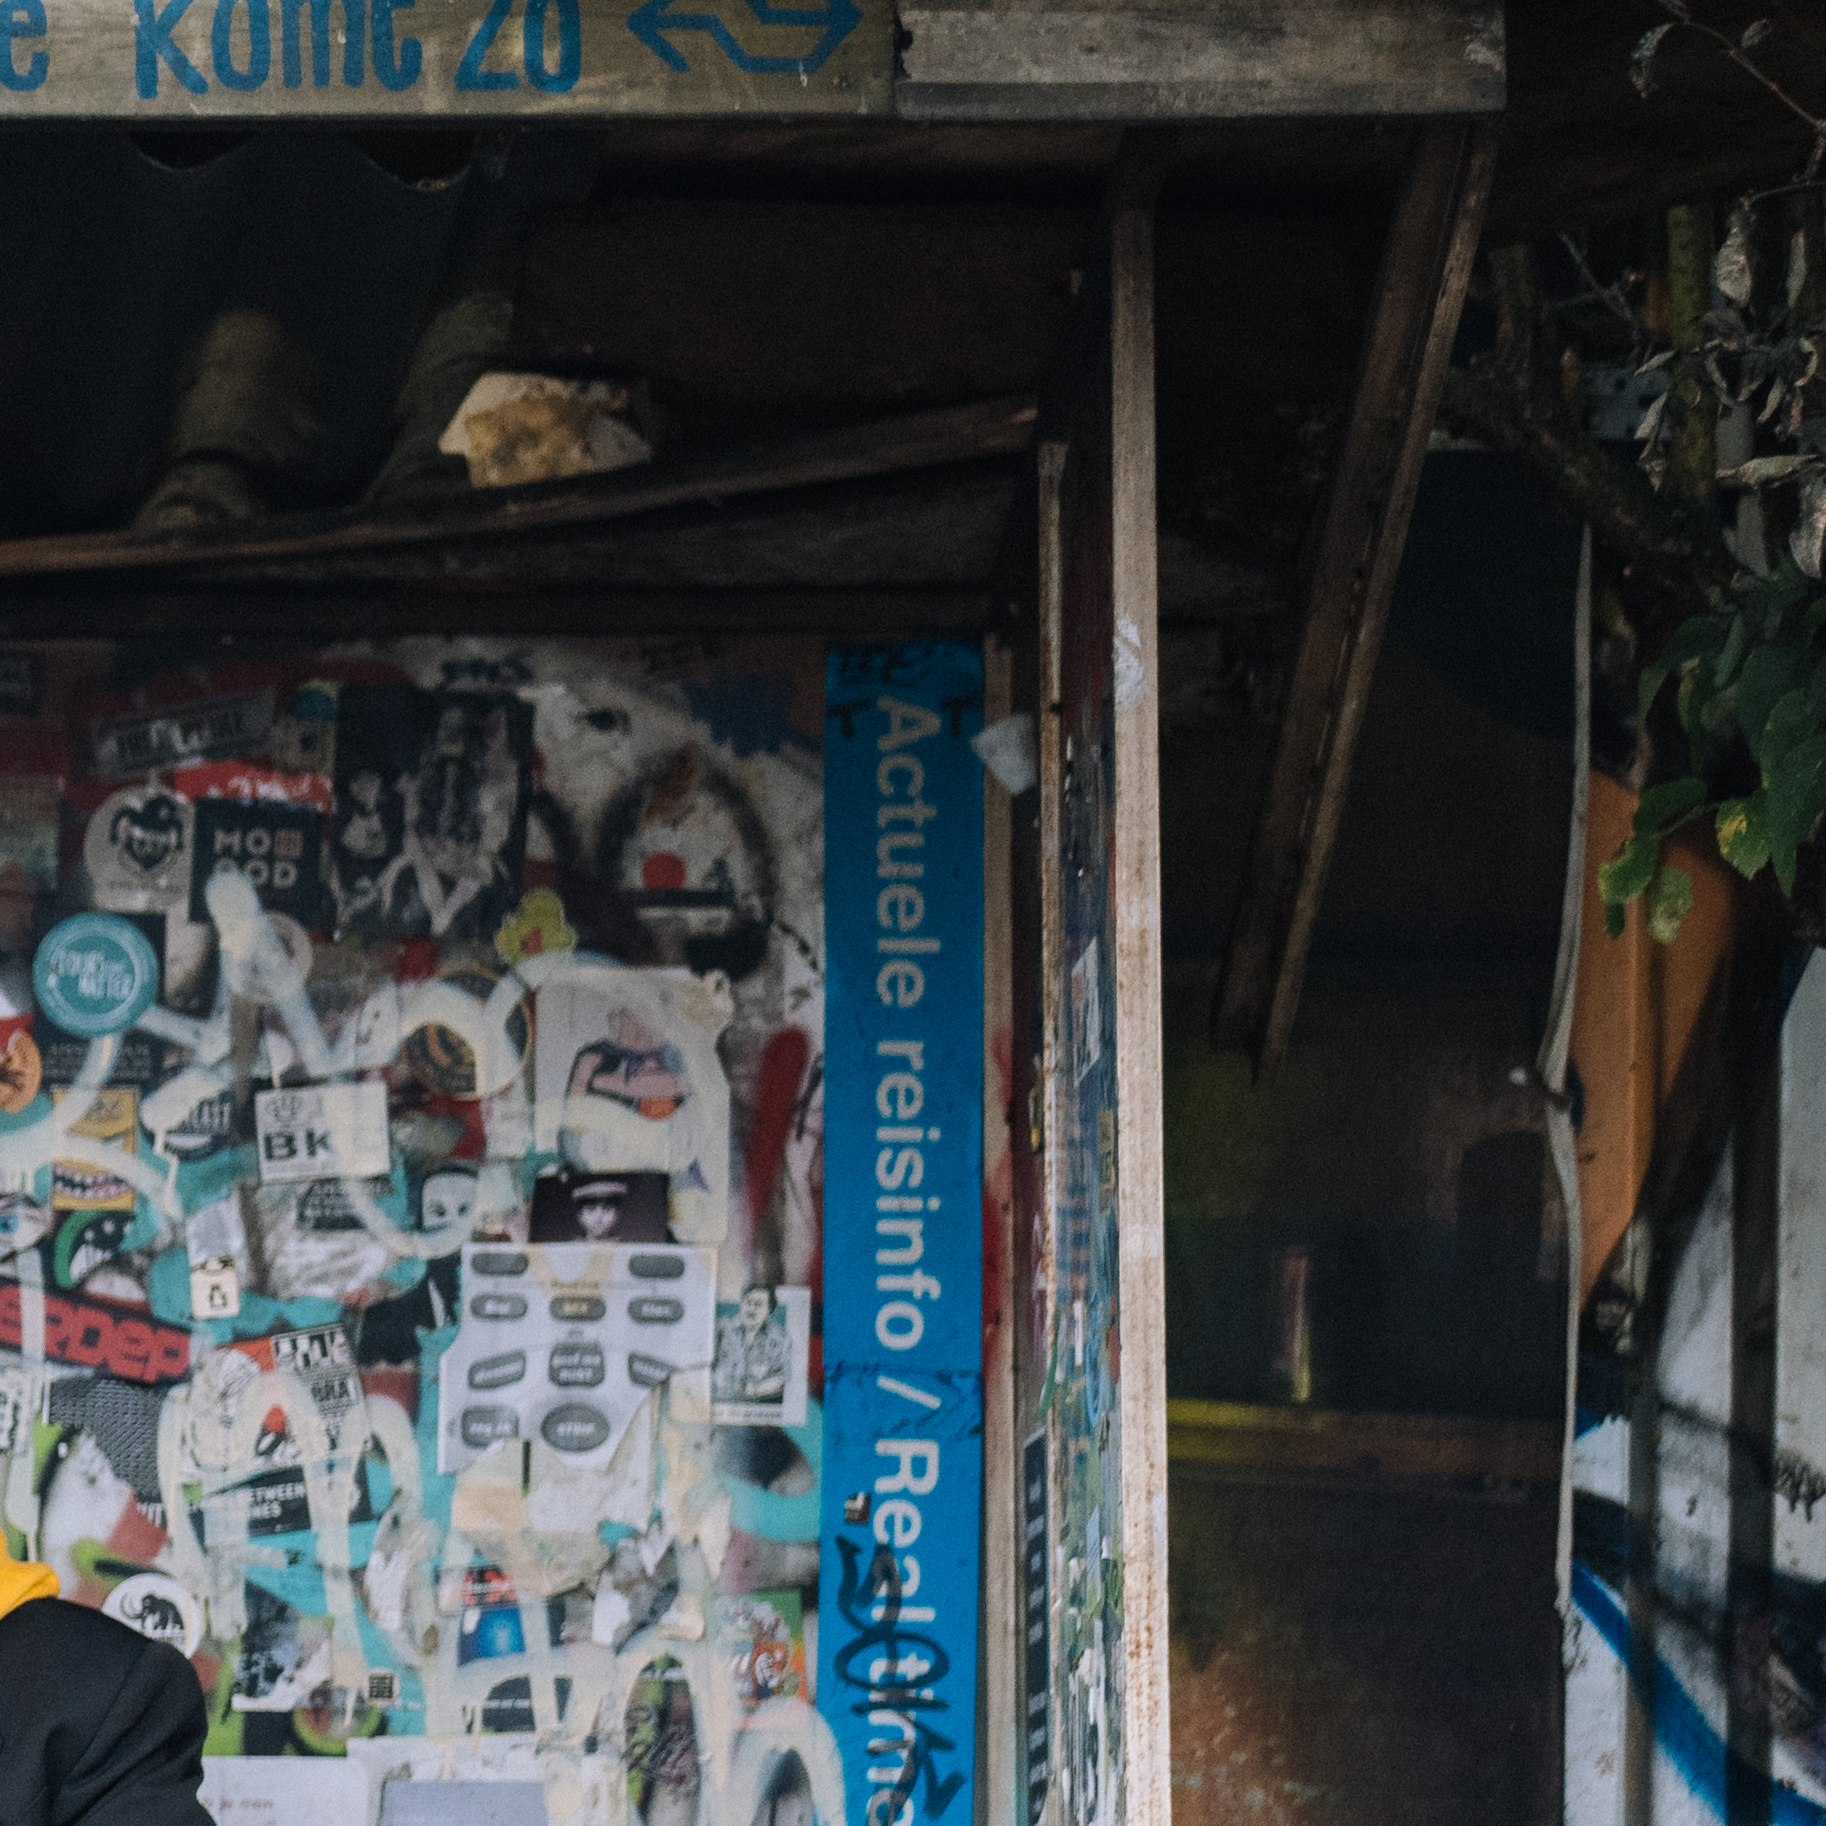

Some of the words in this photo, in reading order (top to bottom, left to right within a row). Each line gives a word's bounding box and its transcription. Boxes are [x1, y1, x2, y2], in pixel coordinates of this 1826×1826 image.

[876, 697, 942, 1008] Actuele
[875, 1041, 941, 1351] reisinfo
[869, 1438, 940, 1622] Real
